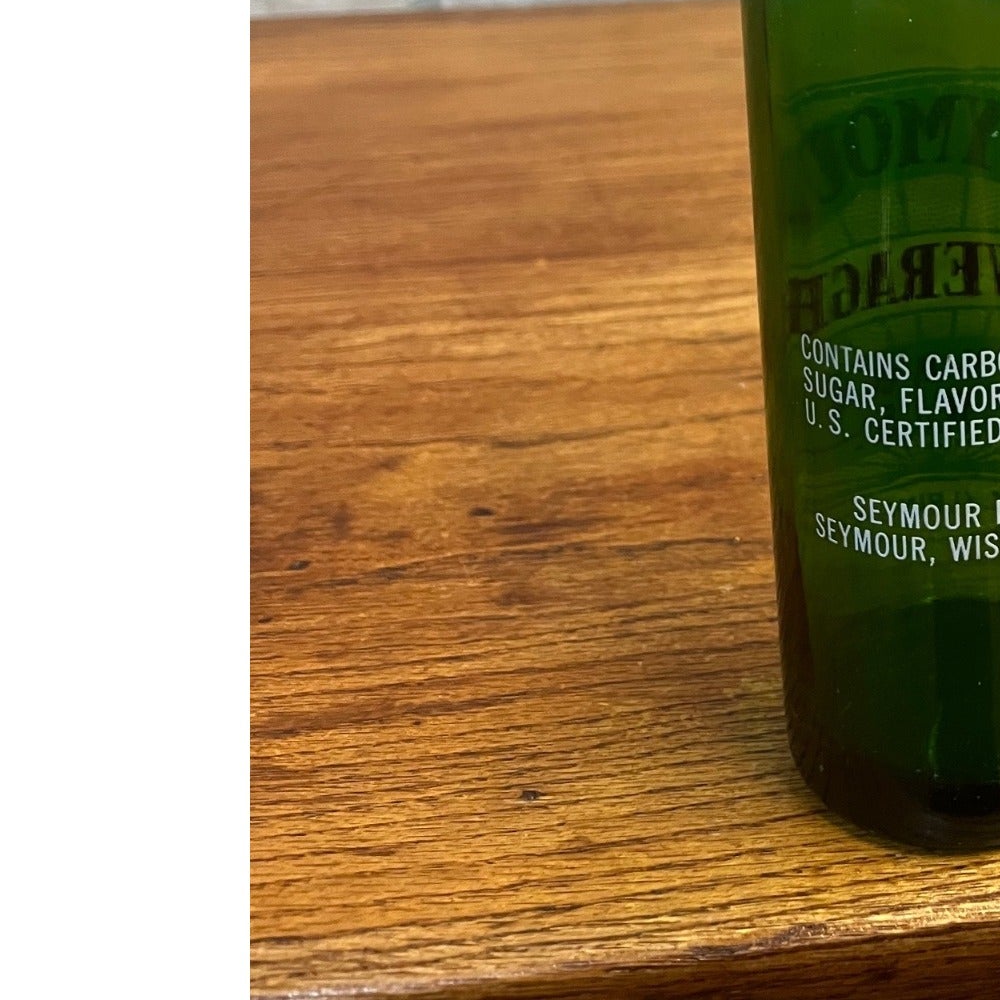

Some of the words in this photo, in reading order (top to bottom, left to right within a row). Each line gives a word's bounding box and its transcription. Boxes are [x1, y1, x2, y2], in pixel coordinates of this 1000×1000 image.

[801, 333, 910, 380] CONTAINS
[803, 366, 886, 416] SUGAR,
[853, 495, 981, 530] SEYMOUR
[815, 512, 936, 566] SEYMOUR,
